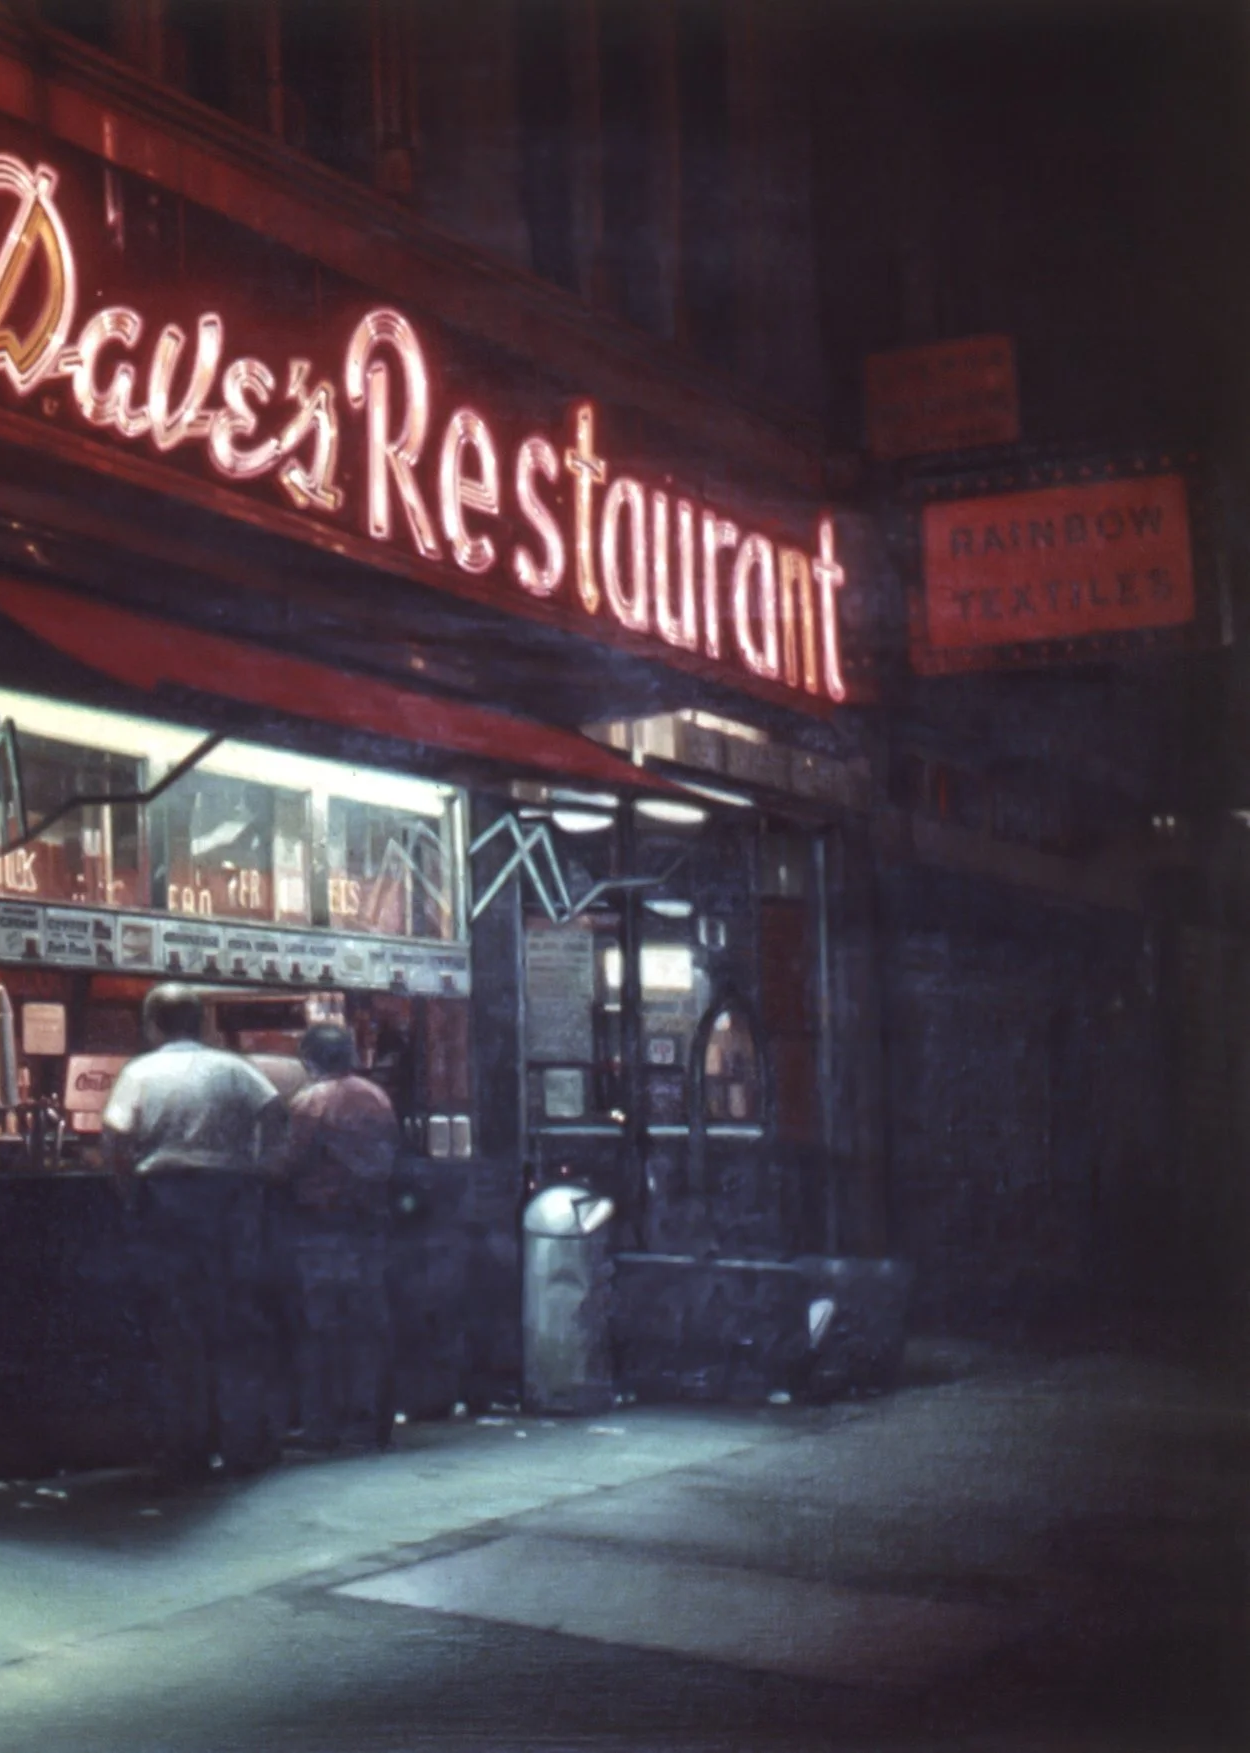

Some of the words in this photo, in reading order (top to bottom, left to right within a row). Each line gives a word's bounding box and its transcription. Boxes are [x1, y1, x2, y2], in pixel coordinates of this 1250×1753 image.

[347, 306, 847, 703] Restaurant
[951, 504, 1164, 560] RAINBOW
[952, 567, 1174, 622] TEXTILES
